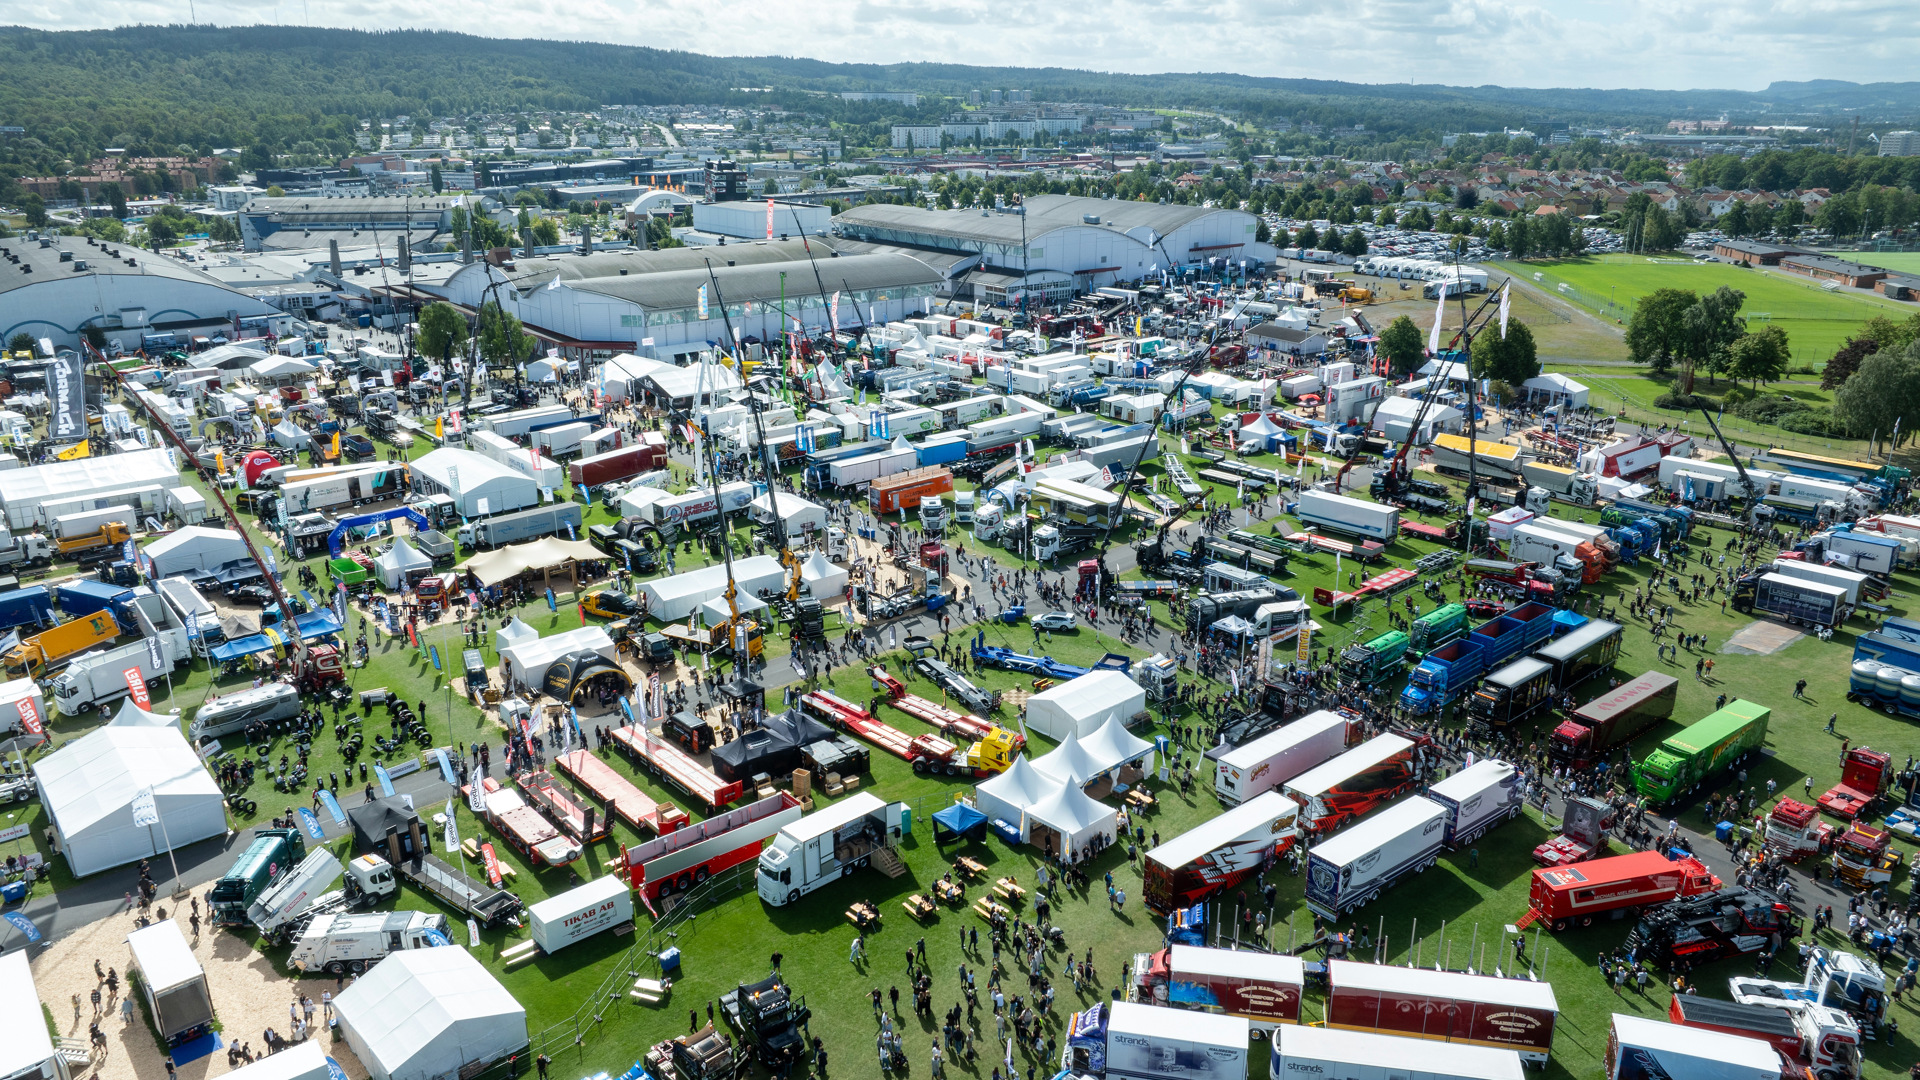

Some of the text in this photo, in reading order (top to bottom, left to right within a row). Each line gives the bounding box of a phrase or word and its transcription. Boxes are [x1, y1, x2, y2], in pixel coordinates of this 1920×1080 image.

[54, 357, 76, 435] CORMACH
[683, 505, 718, 517] AMERICA
[684, 500, 714, 511] SHELBY
[1297, 628, 1310, 662] TRAILER
[1617, 888, 1639, 896] NIELSEN
[563, 907, 596, 928] TIKAB
[598, 901, 616, 915] AB
[1241, 993, 1275, 1002] TRANSPORT
[1491, 1020, 1527, 1028] TRANSPORT
[1114, 1035, 1149, 1047] strands
[1287, 1062, 1324, 1074] strands
